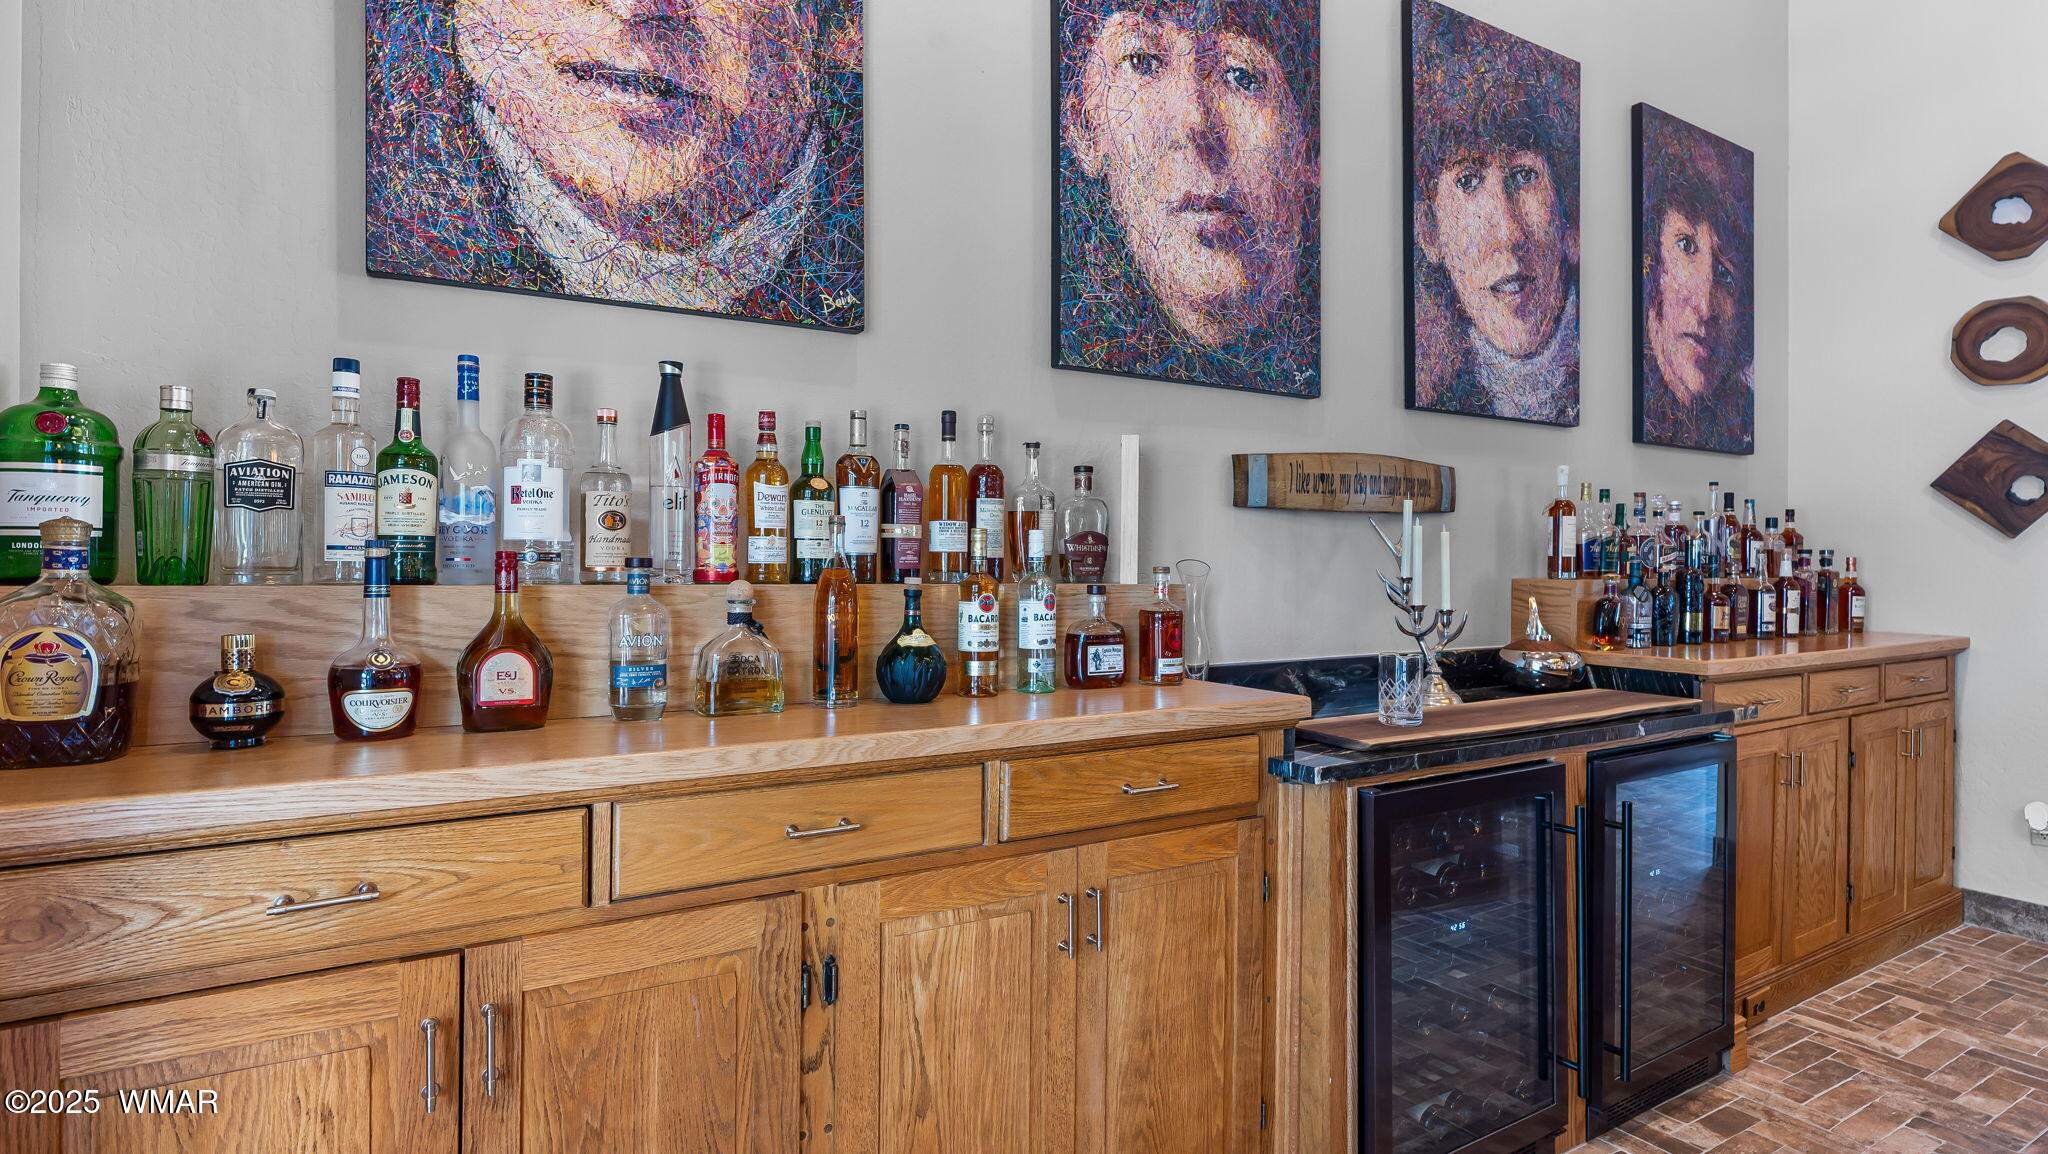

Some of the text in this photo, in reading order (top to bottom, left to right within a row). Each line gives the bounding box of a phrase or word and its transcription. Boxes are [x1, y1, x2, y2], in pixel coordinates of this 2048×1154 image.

[230, 466, 290, 479] AVIATION
[379, 474, 433, 490] JAMESON
[1296, 460, 1310, 494] like
[1340, 473, 1352, 505] my
[1370, 463, 1382, 495] and
[8, 489, 91, 506] Tanqueray
[511, 486, 554, 501] Ketel One
[593, 492, 630, 508] Tito's
[860, 520, 870, 528] 12
[618, 632, 664, 648] AVIÓN
[8, 670, 84, 686] Crown Royal
[496, 670, 518, 680] E&J
[350, 697, 408, 708] COURVOISIER
